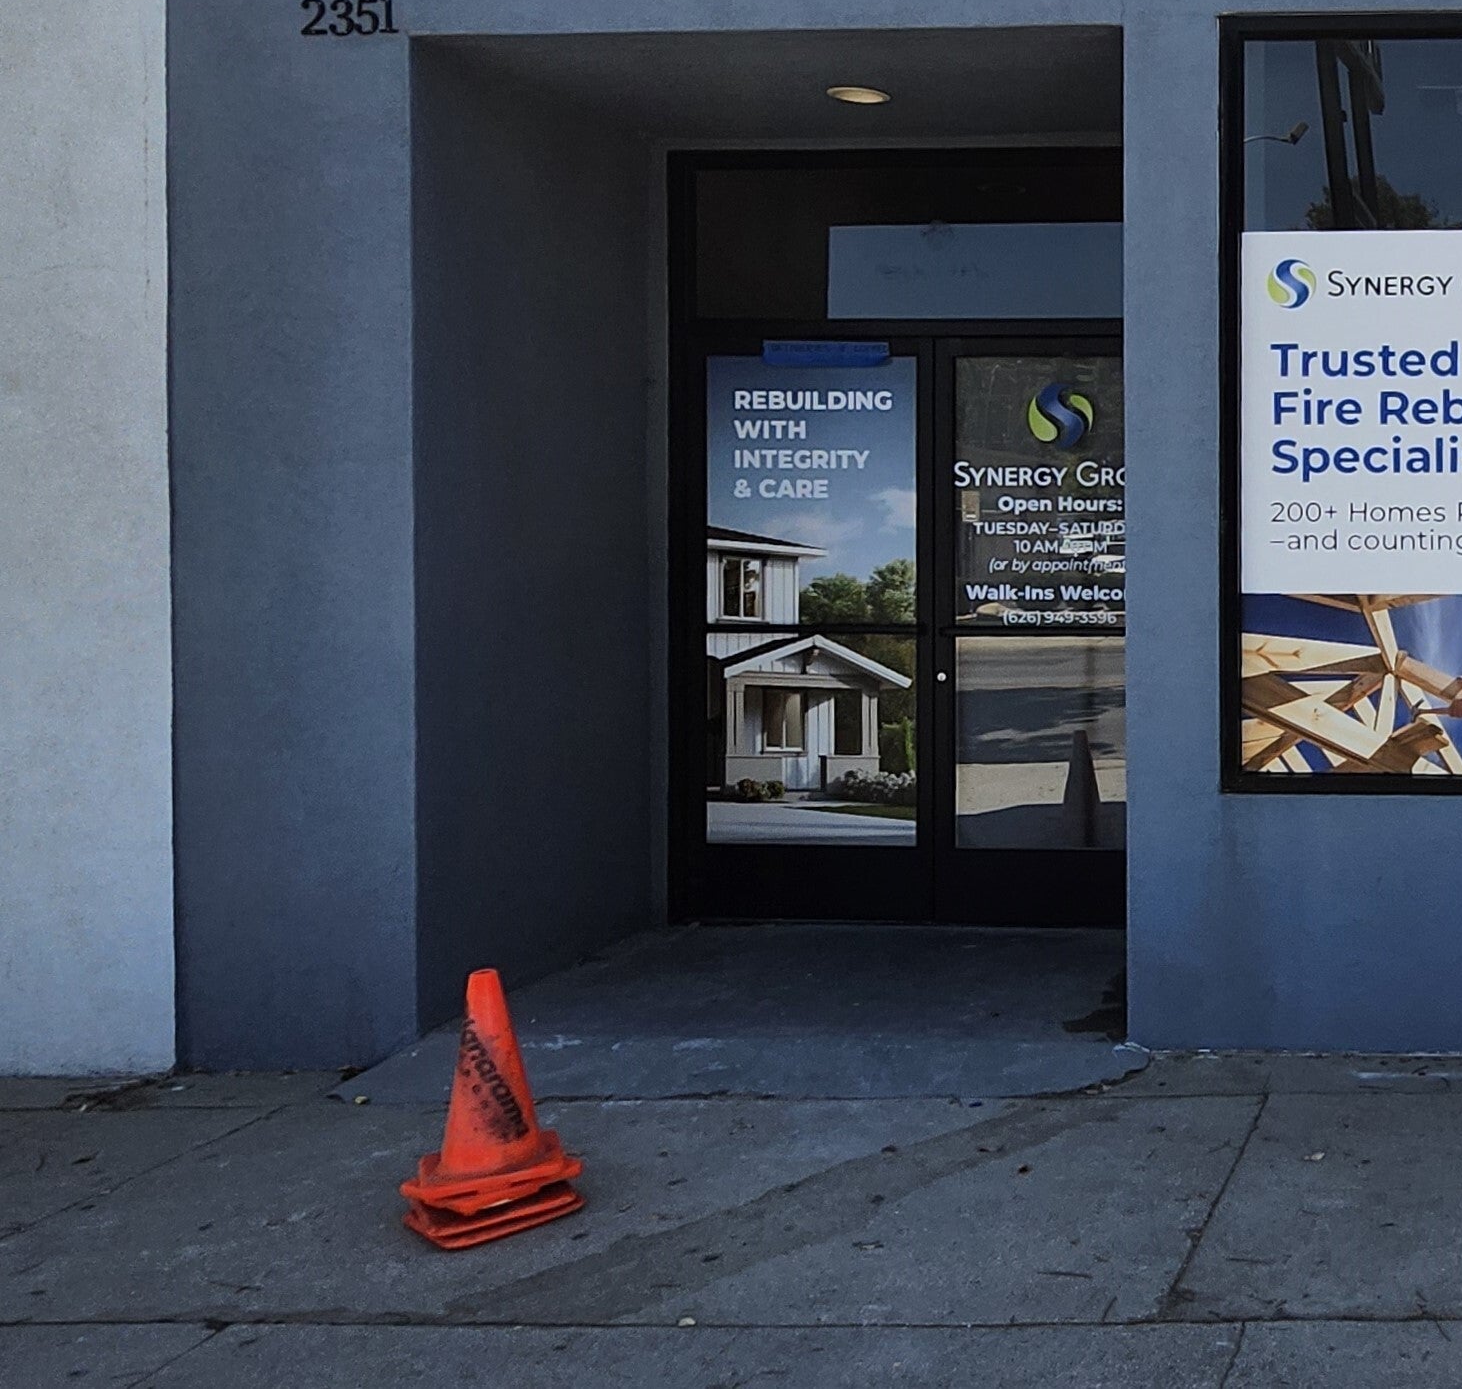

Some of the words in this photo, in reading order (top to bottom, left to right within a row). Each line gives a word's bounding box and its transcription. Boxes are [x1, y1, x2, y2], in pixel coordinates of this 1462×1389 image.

[1327, 270, 1453, 297] SYNERGY
[1270, 341, 1459, 377] Trusted
[734, 390, 892, 410] REBUILDING
[1273, 388, 1362, 425] Fire
[733, 420, 806, 439] WITH
[734, 450, 870, 469] INTEGRITY
[954, 461, 1068, 487] SYNERGY
[734, 479, 751, 498] &
[759, 479, 828, 498] CARE
[998, 496, 1052, 515] Open
[1058, 496, 1122, 511] Hours:
[1270, 502, 1337, 523] 200+
[1349, 502, 1445, 523] Homes
[973, 522, 1125, 535] TUESDAY–SATURD
[989, 558, 1008, 573] (or
[1012, 558, 1031, 573] by
[966, 585, 1054, 600] Walk-Ins
[1061, 585, 1125, 600] Welco
[1003, 611, 1041, 625] (626)
